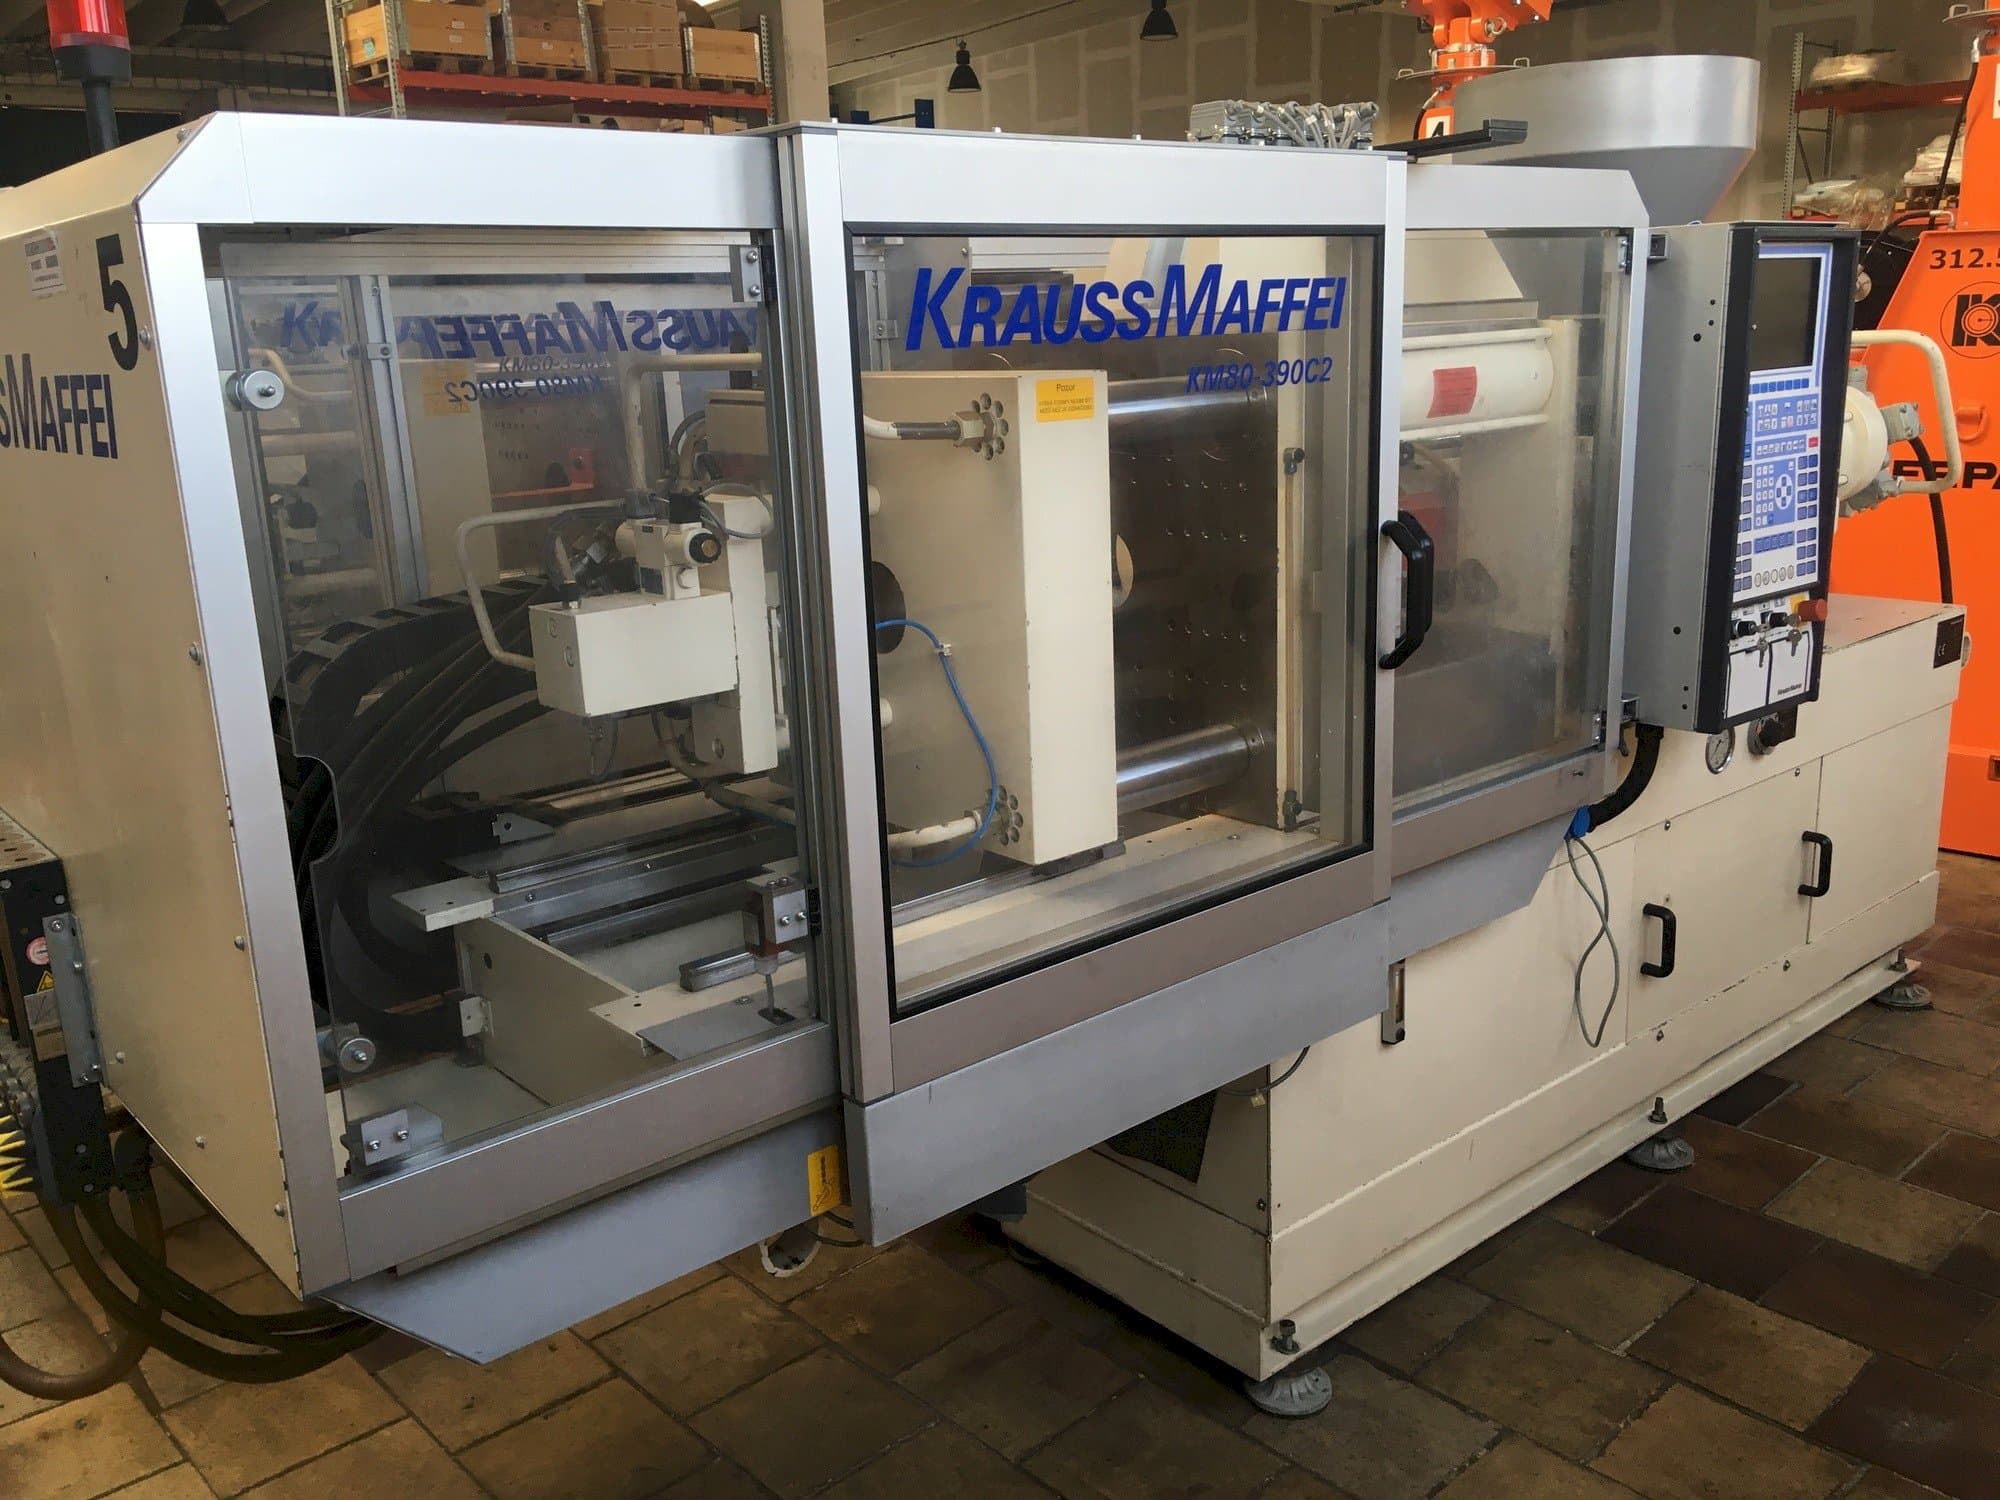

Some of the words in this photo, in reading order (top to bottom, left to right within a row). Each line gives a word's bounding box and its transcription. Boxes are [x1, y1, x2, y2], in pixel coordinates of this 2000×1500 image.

[1929, 248, 2000, 270] 312.
[95, 233, 139, 371] 5
[1185, 356, 1334, 394] KM80-390C2
